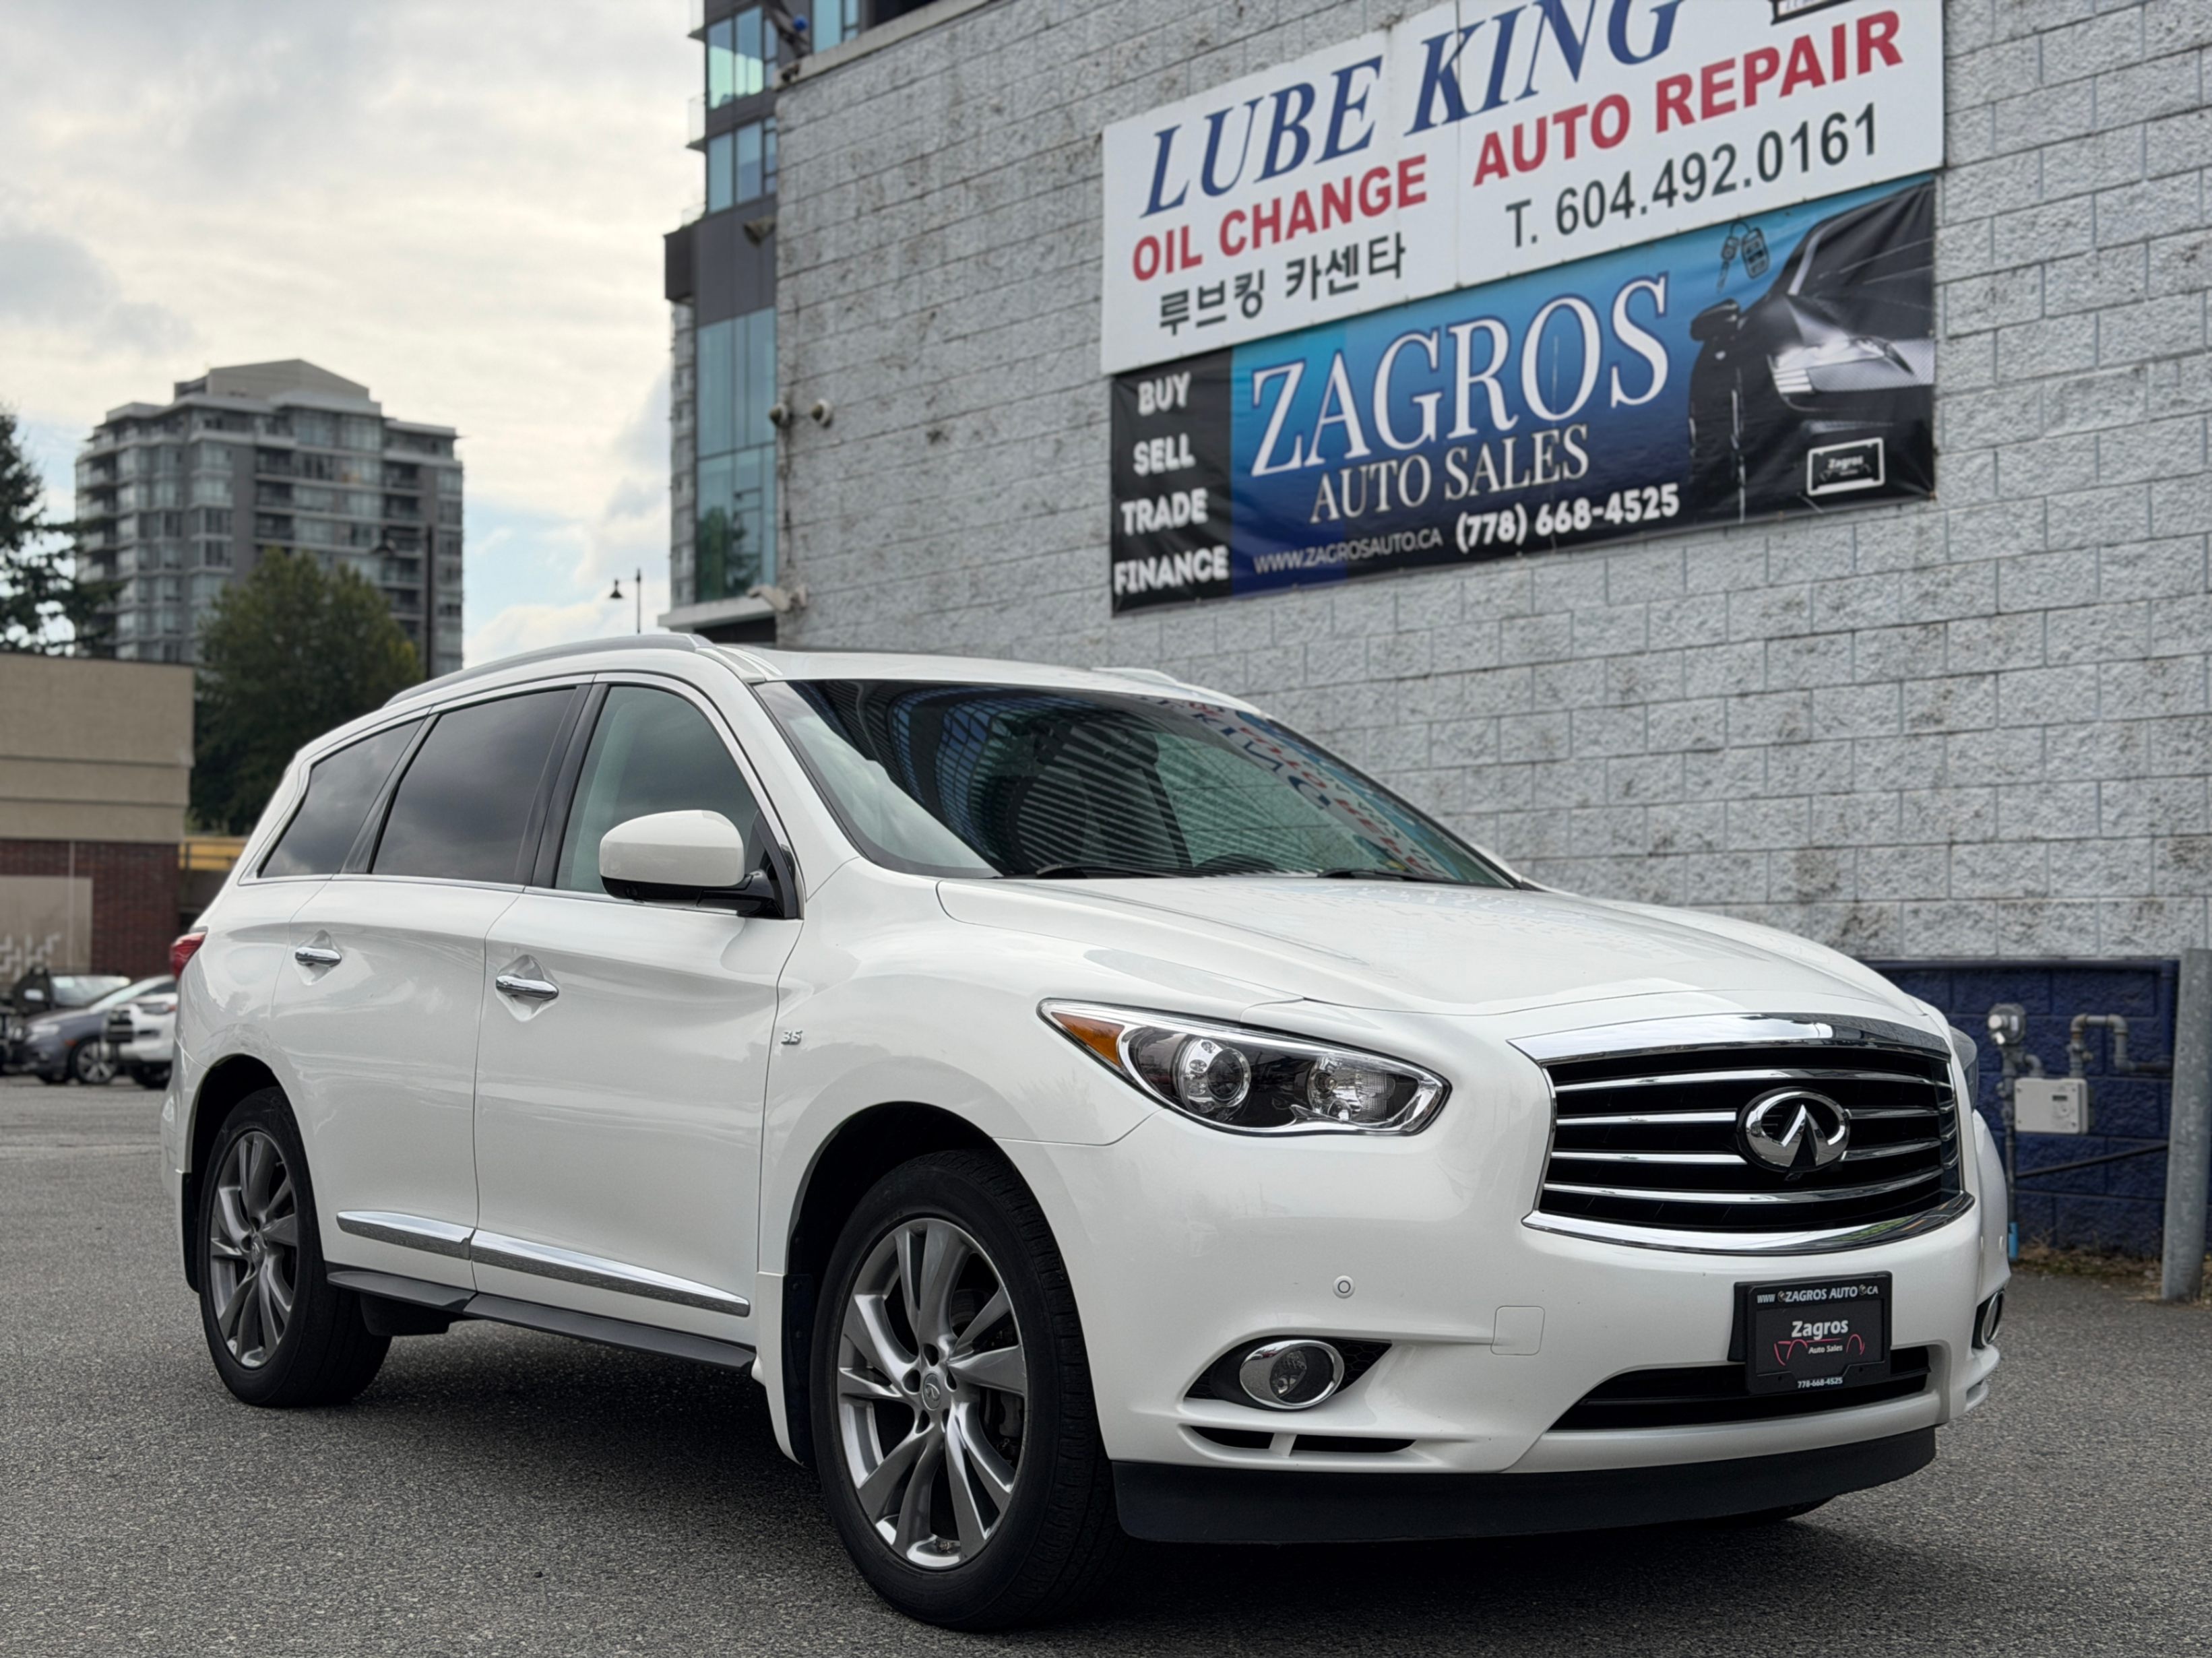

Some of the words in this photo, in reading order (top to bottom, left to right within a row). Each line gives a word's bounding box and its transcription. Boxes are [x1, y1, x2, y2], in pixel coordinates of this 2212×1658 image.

[1139, 55, 1383, 218] LUBE
[1403, 0, 1682, 136] KING
[1132, 224, 1203, 282] OIL
[1220, 154, 1426, 257] CHANGE
[1473, 94, 1631, 187] AUTO
[1656, 10, 1903, 133] REPAIR
[1505, 199, 1538, 248] T.
[1556, 102, 1875, 235] 604.492.0161
[1160, 269, 1265, 336] 루브킹
[1286, 232, 1405, 300] 카센타
[1137, 372, 1191, 415] BUY
[1251, 272, 1670, 476] ZAGROS
[1133, 434, 1195, 476] SELL
[1310, 454, 1431, 523] AUTO
[1445, 423, 1589, 501] SALES
[1121, 488, 1208, 536] TRADE
[1253, 528, 1443, 573] WWW.ZAGROSAUTO.CA
[1456, 503, 1527, 554] (778)
[1535, 483, 1680, 536] 668-4525
[1114, 546, 1229, 594] FINANCE
[1757, 1294, 1775, 1304] WWW
[1786, 1288, 1827, 1302] ZAGROS
[1829, 1286, 1858, 1299] AUTO
[1867, 1285, 1878, 1295] CA
[1791, 1320, 1849, 1340] Zagros
[1808, 1346, 1825, 1354] Auto
[1827, 1345, 1843, 1353] Sales
[1798, 1377, 1843, 1389] 778-668-4525
